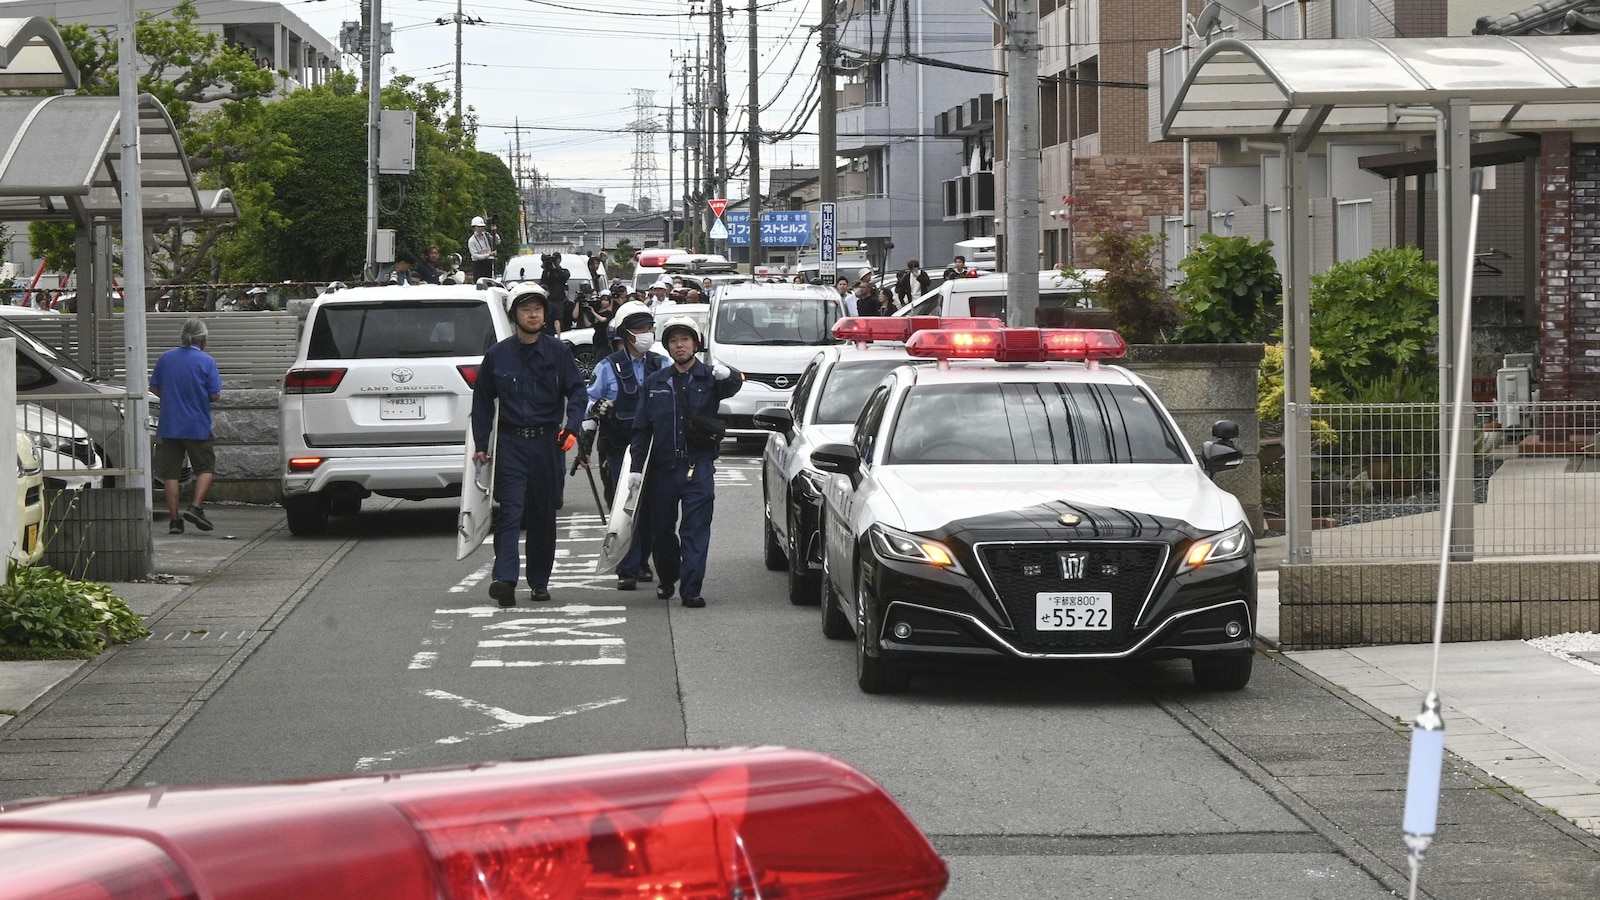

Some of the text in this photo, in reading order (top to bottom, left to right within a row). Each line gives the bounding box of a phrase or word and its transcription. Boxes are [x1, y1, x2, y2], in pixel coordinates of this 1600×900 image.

[737, 223, 807, 234] フストヒルズ
[1041, 608, 1107, 627] せ 55-22
